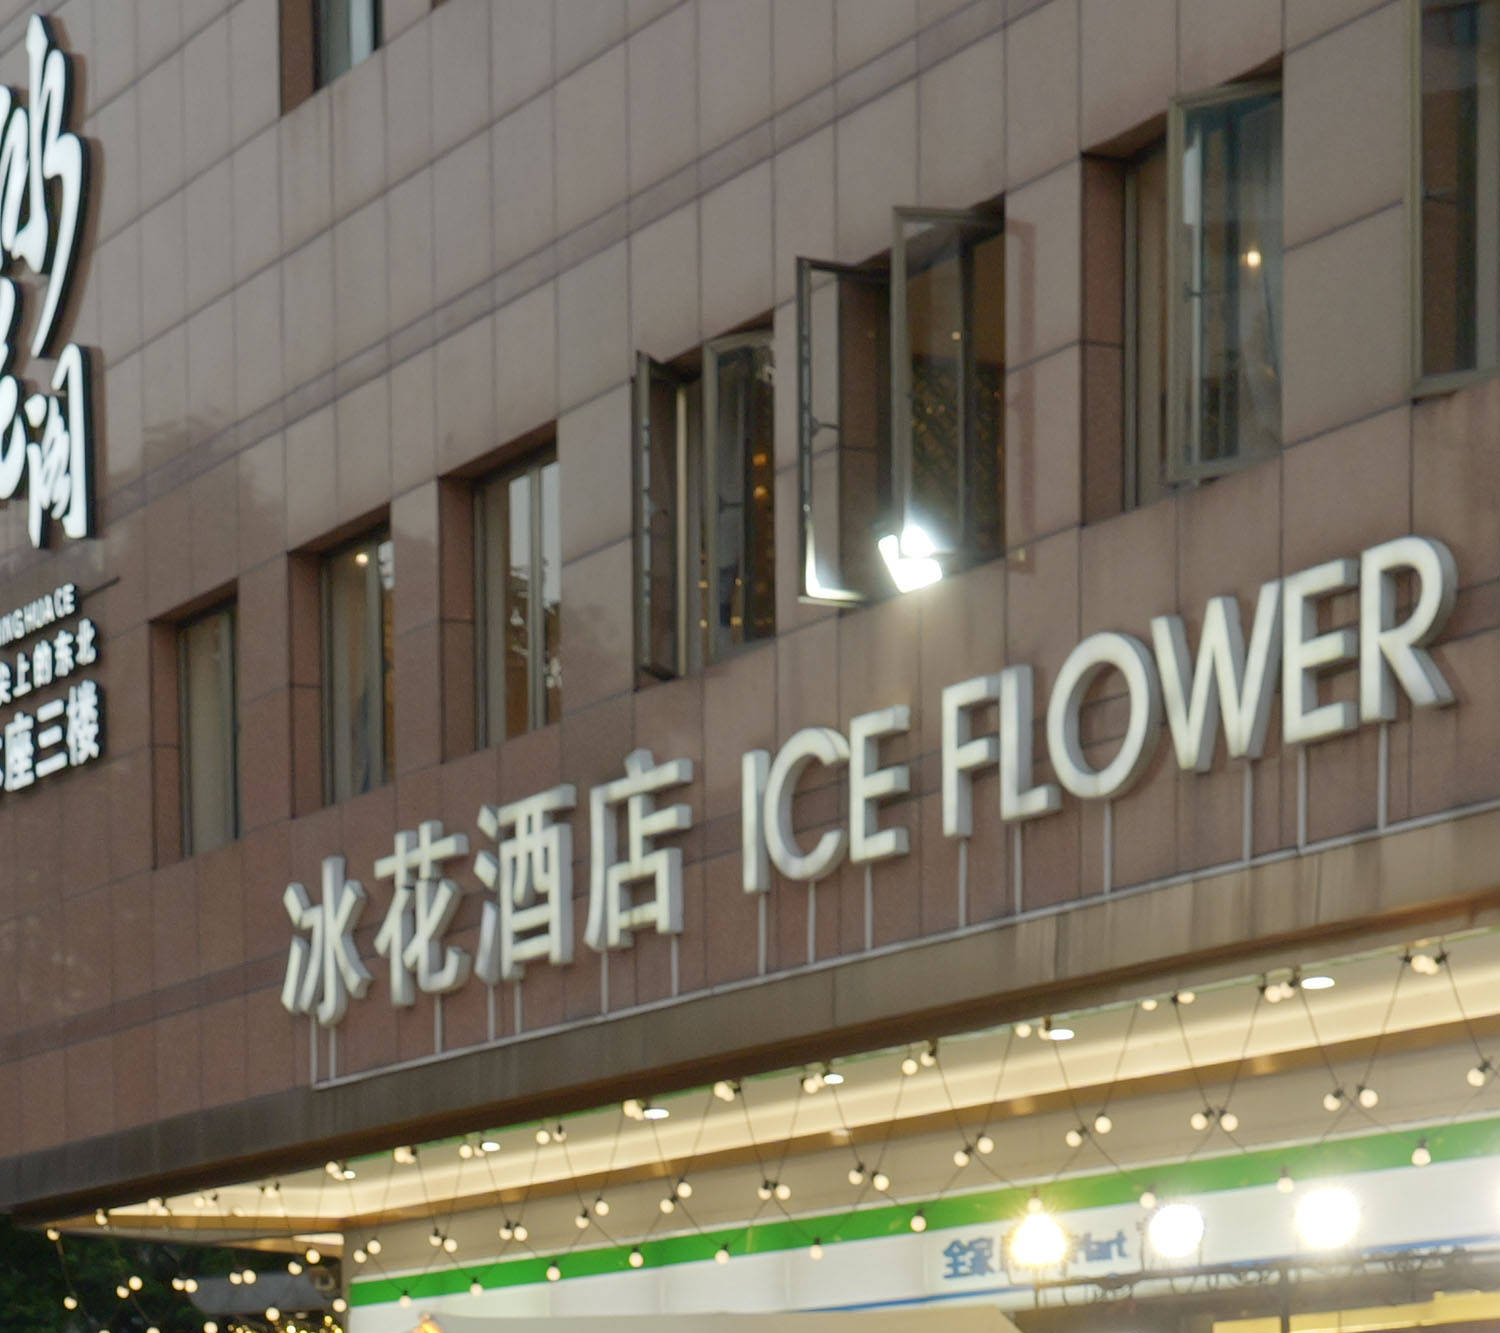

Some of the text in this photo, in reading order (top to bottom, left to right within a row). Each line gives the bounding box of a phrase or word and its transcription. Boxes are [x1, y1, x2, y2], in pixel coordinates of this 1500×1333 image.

[281, 747, 694, 1028] 冰花酒店
[741, 704, 911, 895] ICE
[941, 534, 1457, 840] FLOWER
[942, 1237, 995, 1279] 全家
